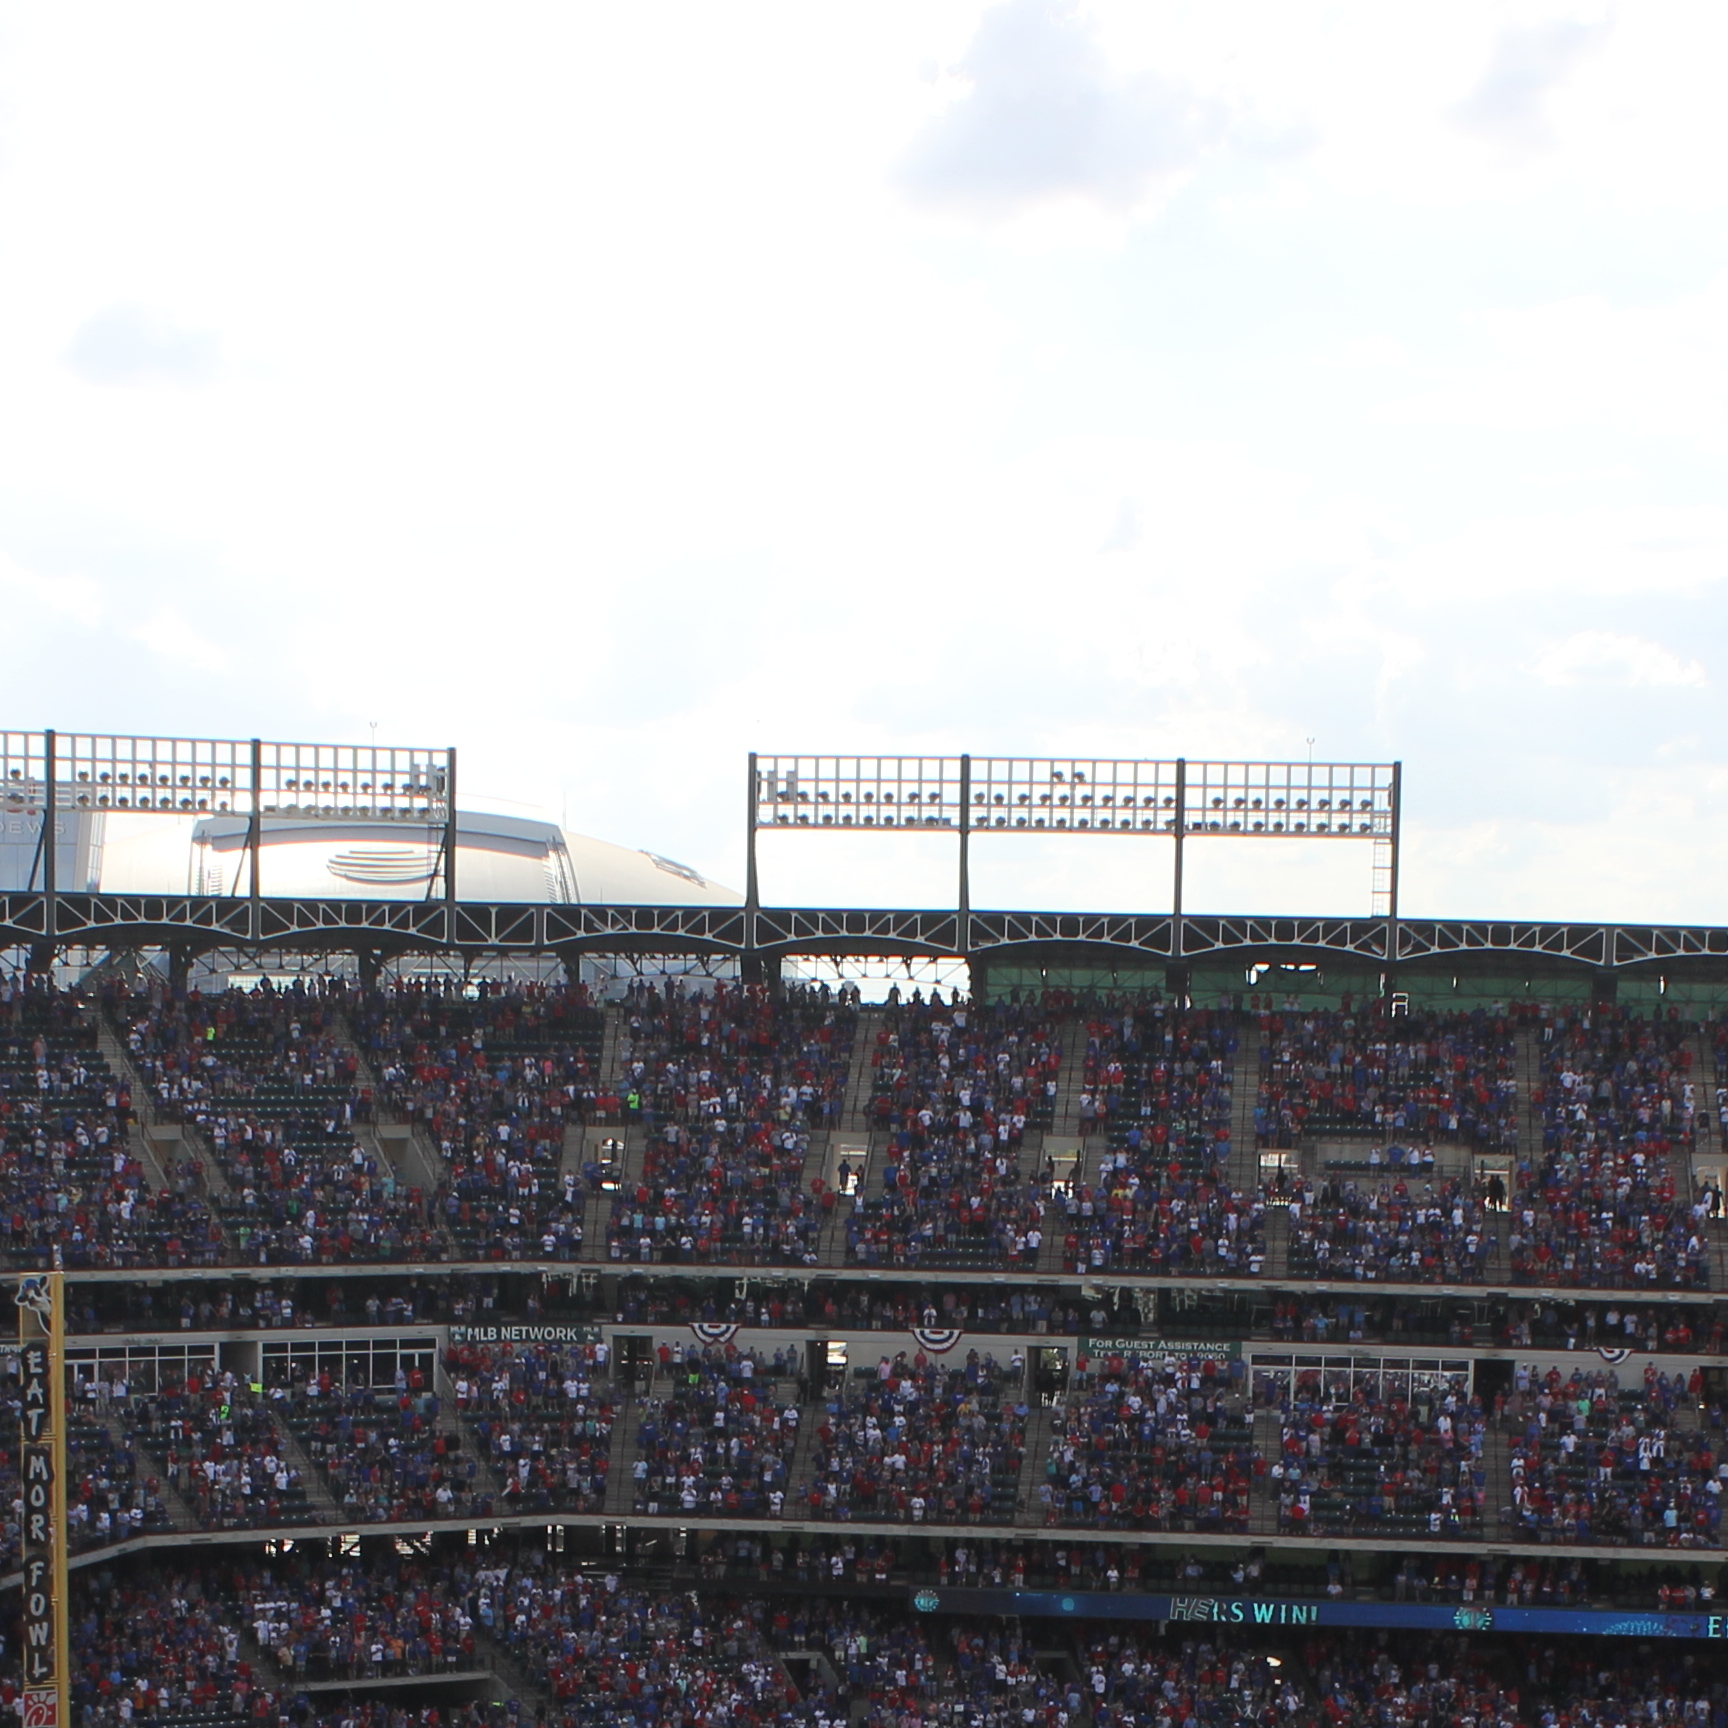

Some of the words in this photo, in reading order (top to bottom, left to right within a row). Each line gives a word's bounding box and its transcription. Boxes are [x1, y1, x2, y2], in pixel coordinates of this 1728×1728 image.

[467, 1327, 498, 1341] MLB
[501, 1325, 578, 1342] NETWORK
[1088, 1337, 1113, 1349] FOR
[1115, 1338, 1156, 1350] GUEST
[1157, 1340, 1231, 1352] ASSISTANCE
[26, 1351, 45, 1436] EAT
[28, 1455, 49, 1542] MOR
[29, 1555, 49, 1678] FOWL
[1253, 1602, 1318, 1626] WIN!
